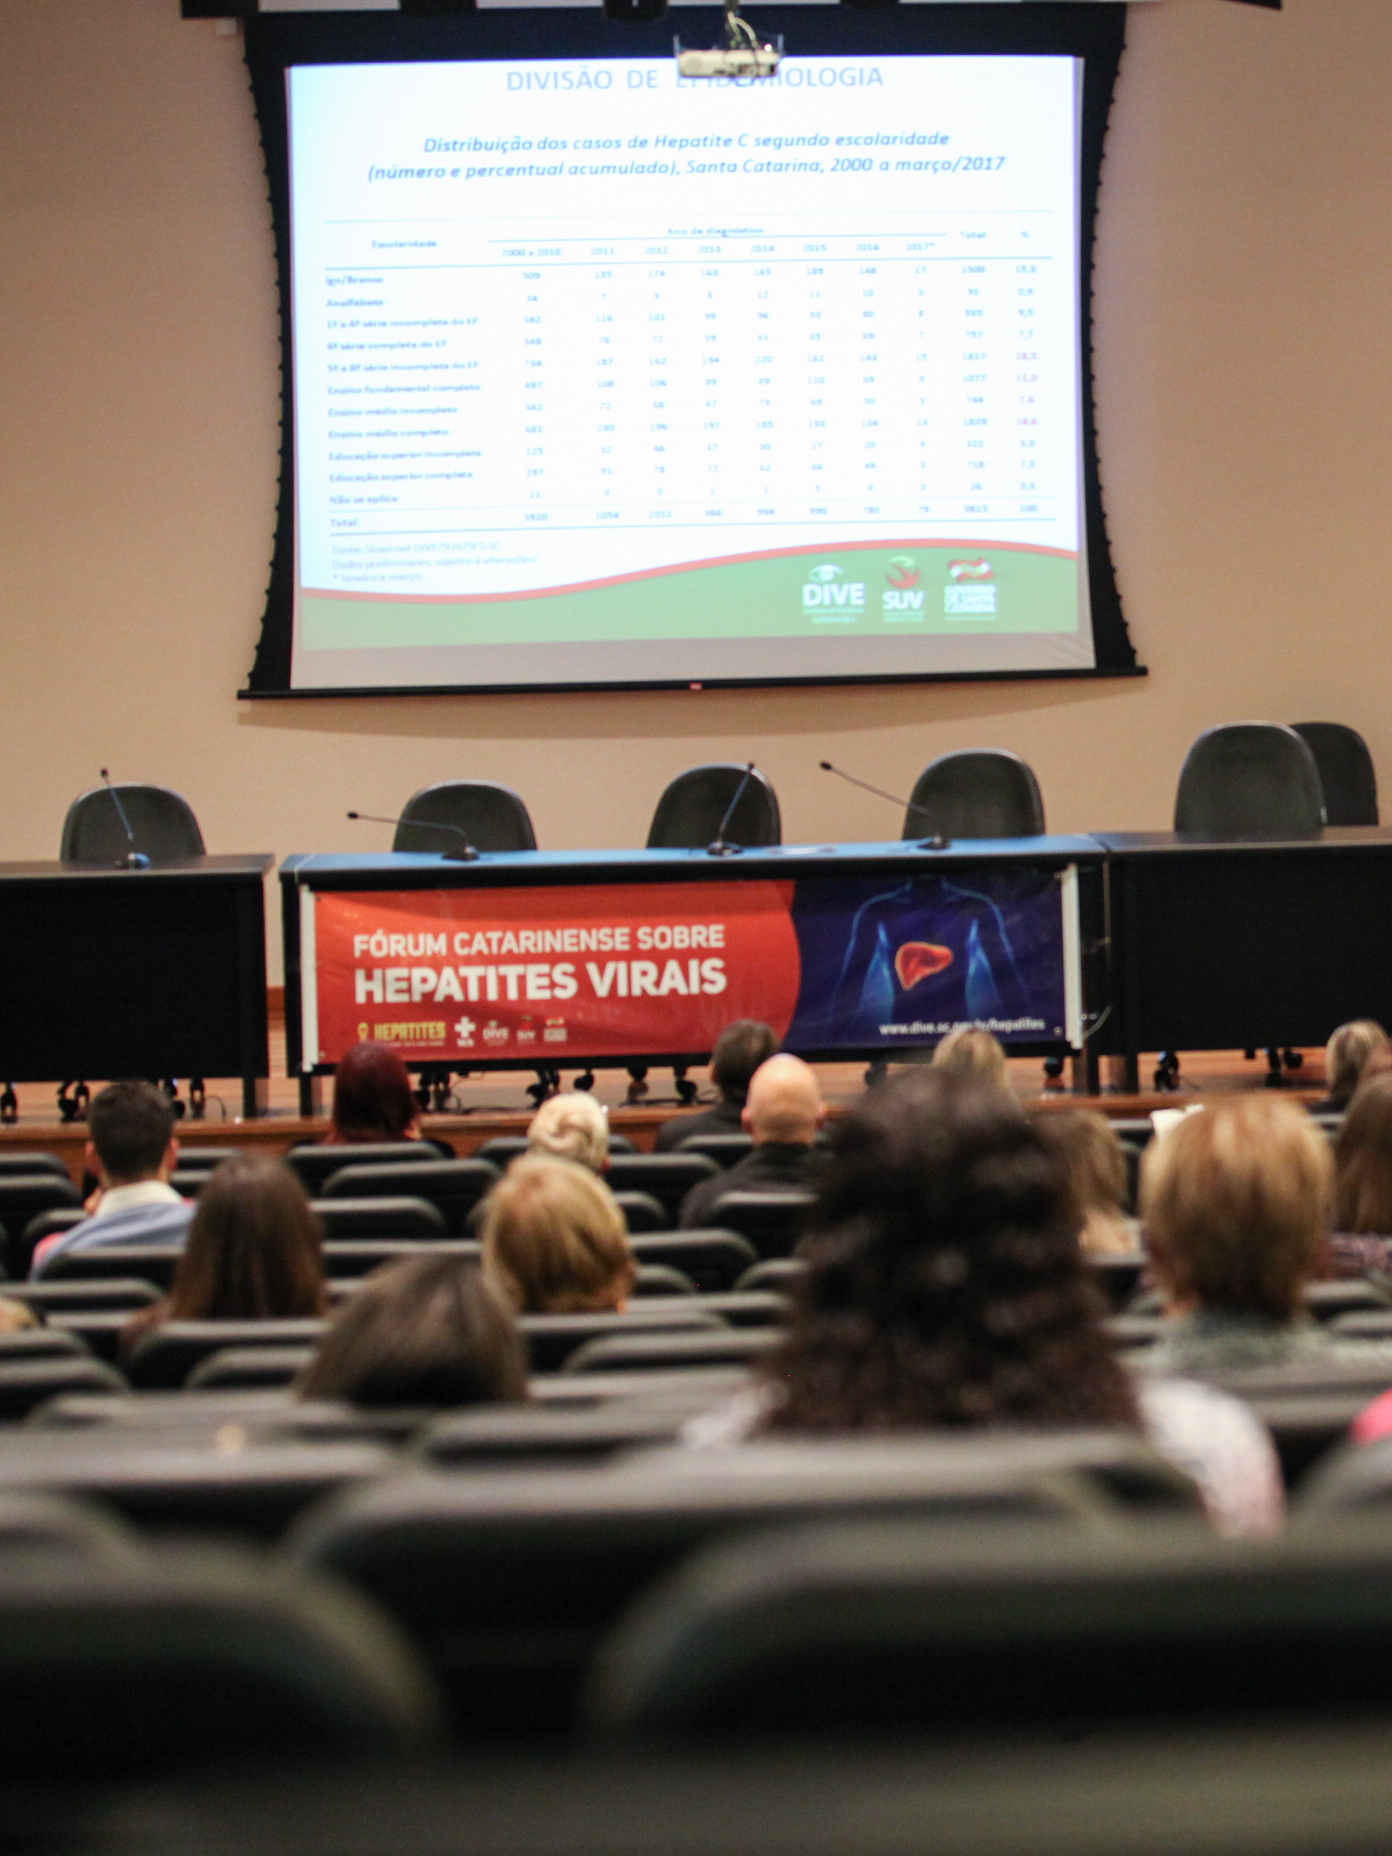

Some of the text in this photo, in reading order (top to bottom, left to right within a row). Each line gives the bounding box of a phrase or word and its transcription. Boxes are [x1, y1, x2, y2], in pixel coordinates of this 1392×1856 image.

[507, 66, 612, 90] DIVISÃO
[628, 70, 658, 88] DE
[424, 131, 950, 154] Distribuição dos casos de Hepatite C segundo escolaridade
[368, 156, 1006, 183] (número e percentual acumulado), Santa Catarina, 2000 a março/2017
[960, 231, 987, 239] Total
[645, 246, 668, 254] 2012
[330, 518, 358, 527] Total
[803, 583, 865, 606] DIVE
[883, 591, 925, 610] SUV
[353, 924, 725, 958] FÓRUM CATARINENSE SOBRE
[355, 958, 727, 1004] HEPATITES VIRAIS
[374, 1022, 446, 1040] HEPATITES
[483, 1028, 509, 1040] DIVE
